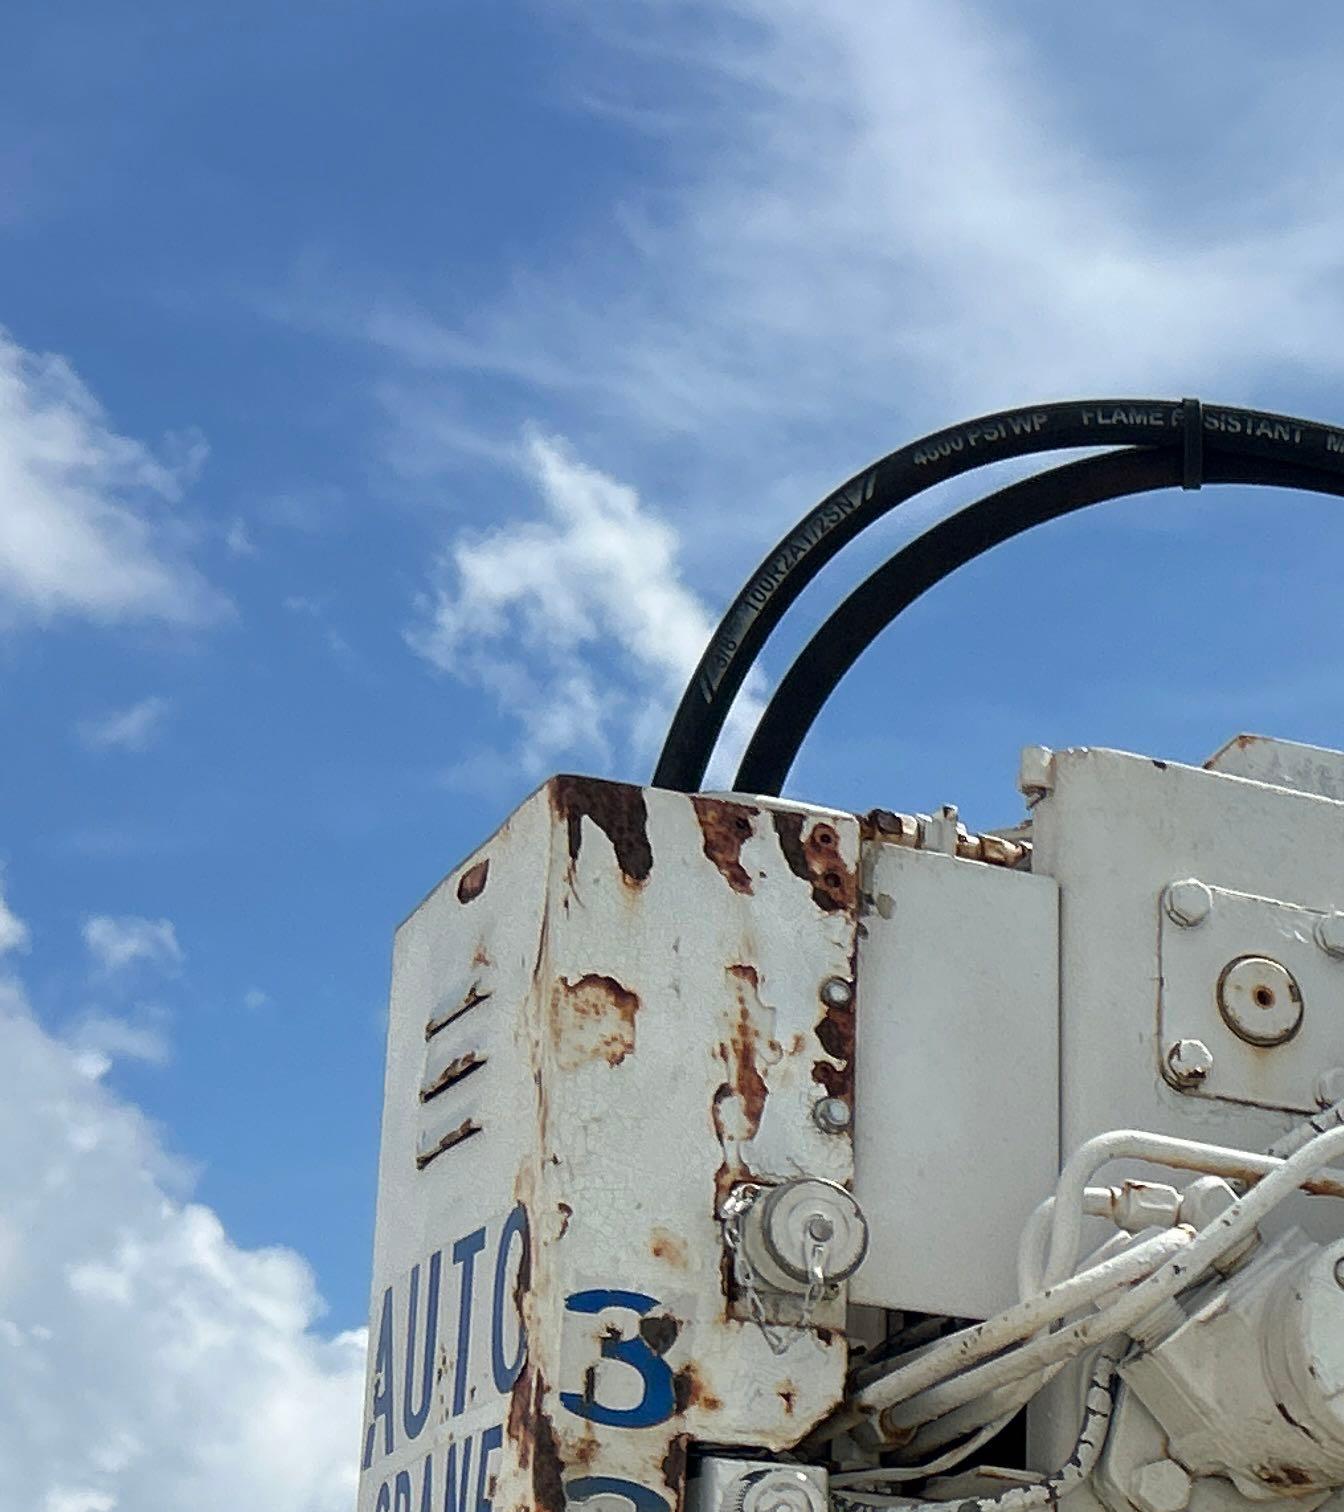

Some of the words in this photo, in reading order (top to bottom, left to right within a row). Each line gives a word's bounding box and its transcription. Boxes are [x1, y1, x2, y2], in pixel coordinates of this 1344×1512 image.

[968, 425, 1007, 448] PSI
[1009, 412, 1048, 438] WP
[1081, 406, 1164, 428] FLAME
[362, 1201, 530, 1472] AUTO
